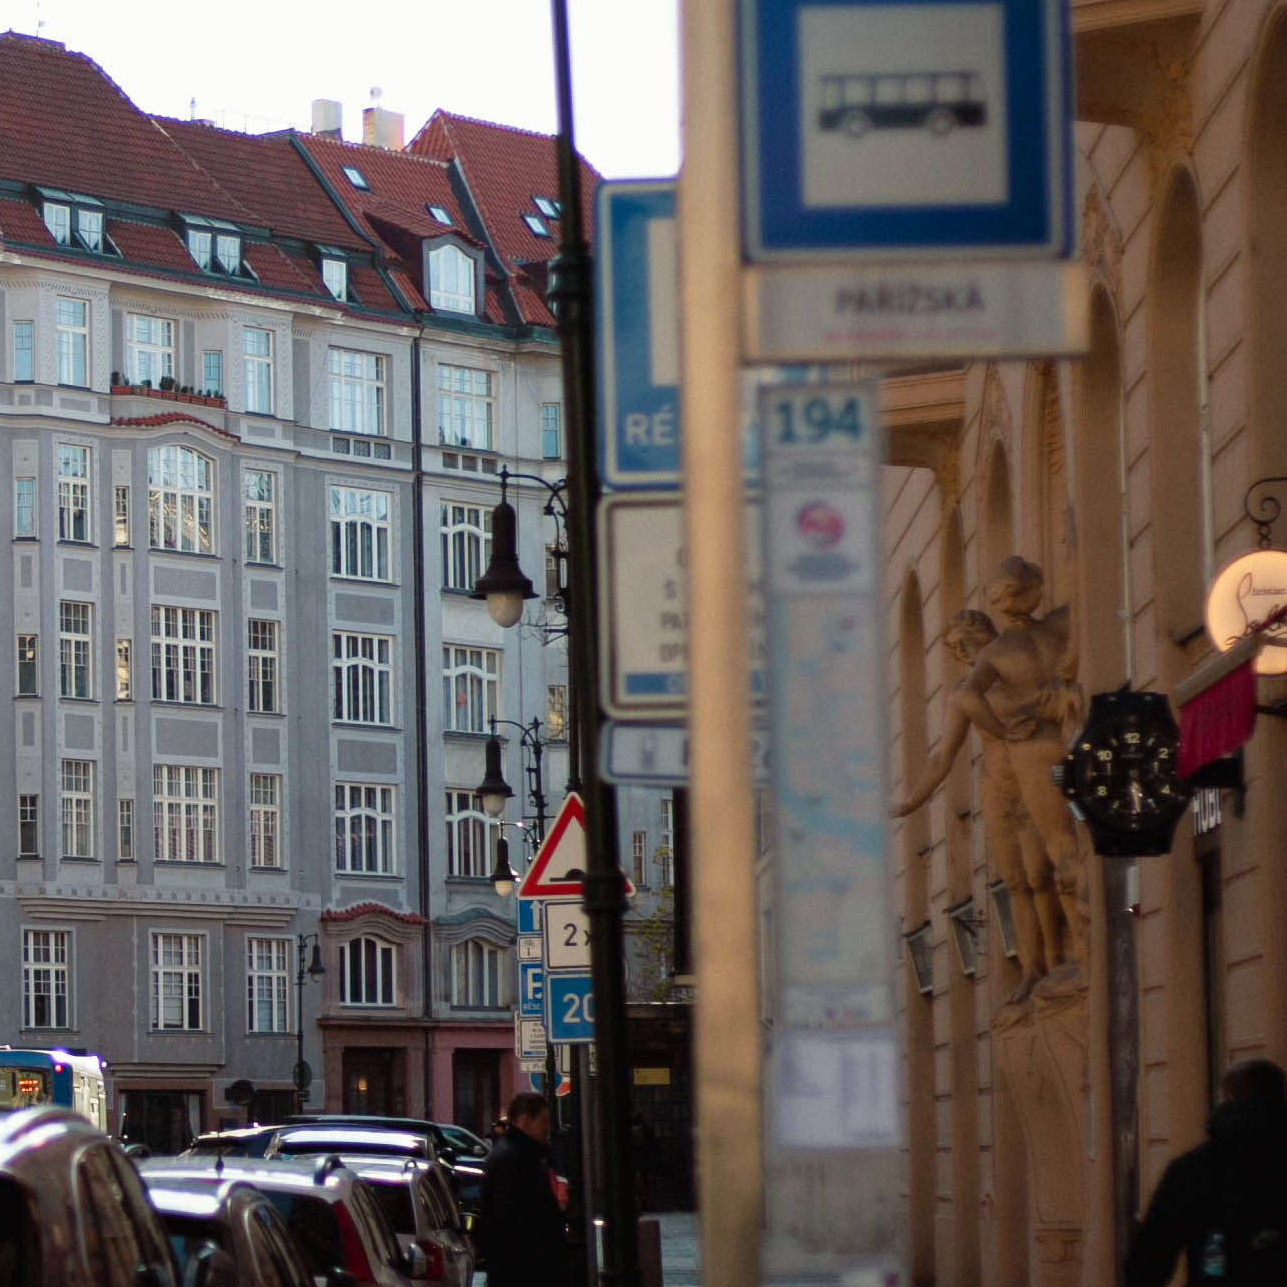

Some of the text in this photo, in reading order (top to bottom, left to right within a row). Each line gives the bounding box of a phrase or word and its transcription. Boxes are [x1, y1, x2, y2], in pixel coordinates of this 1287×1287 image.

[773, 395, 863, 446] 194
[1124, 732, 1141, 744] 12
[1097, 750, 1113, 761] 10
[1158, 747, 1169, 759] 2
[563, 923, 578, 947] 2
